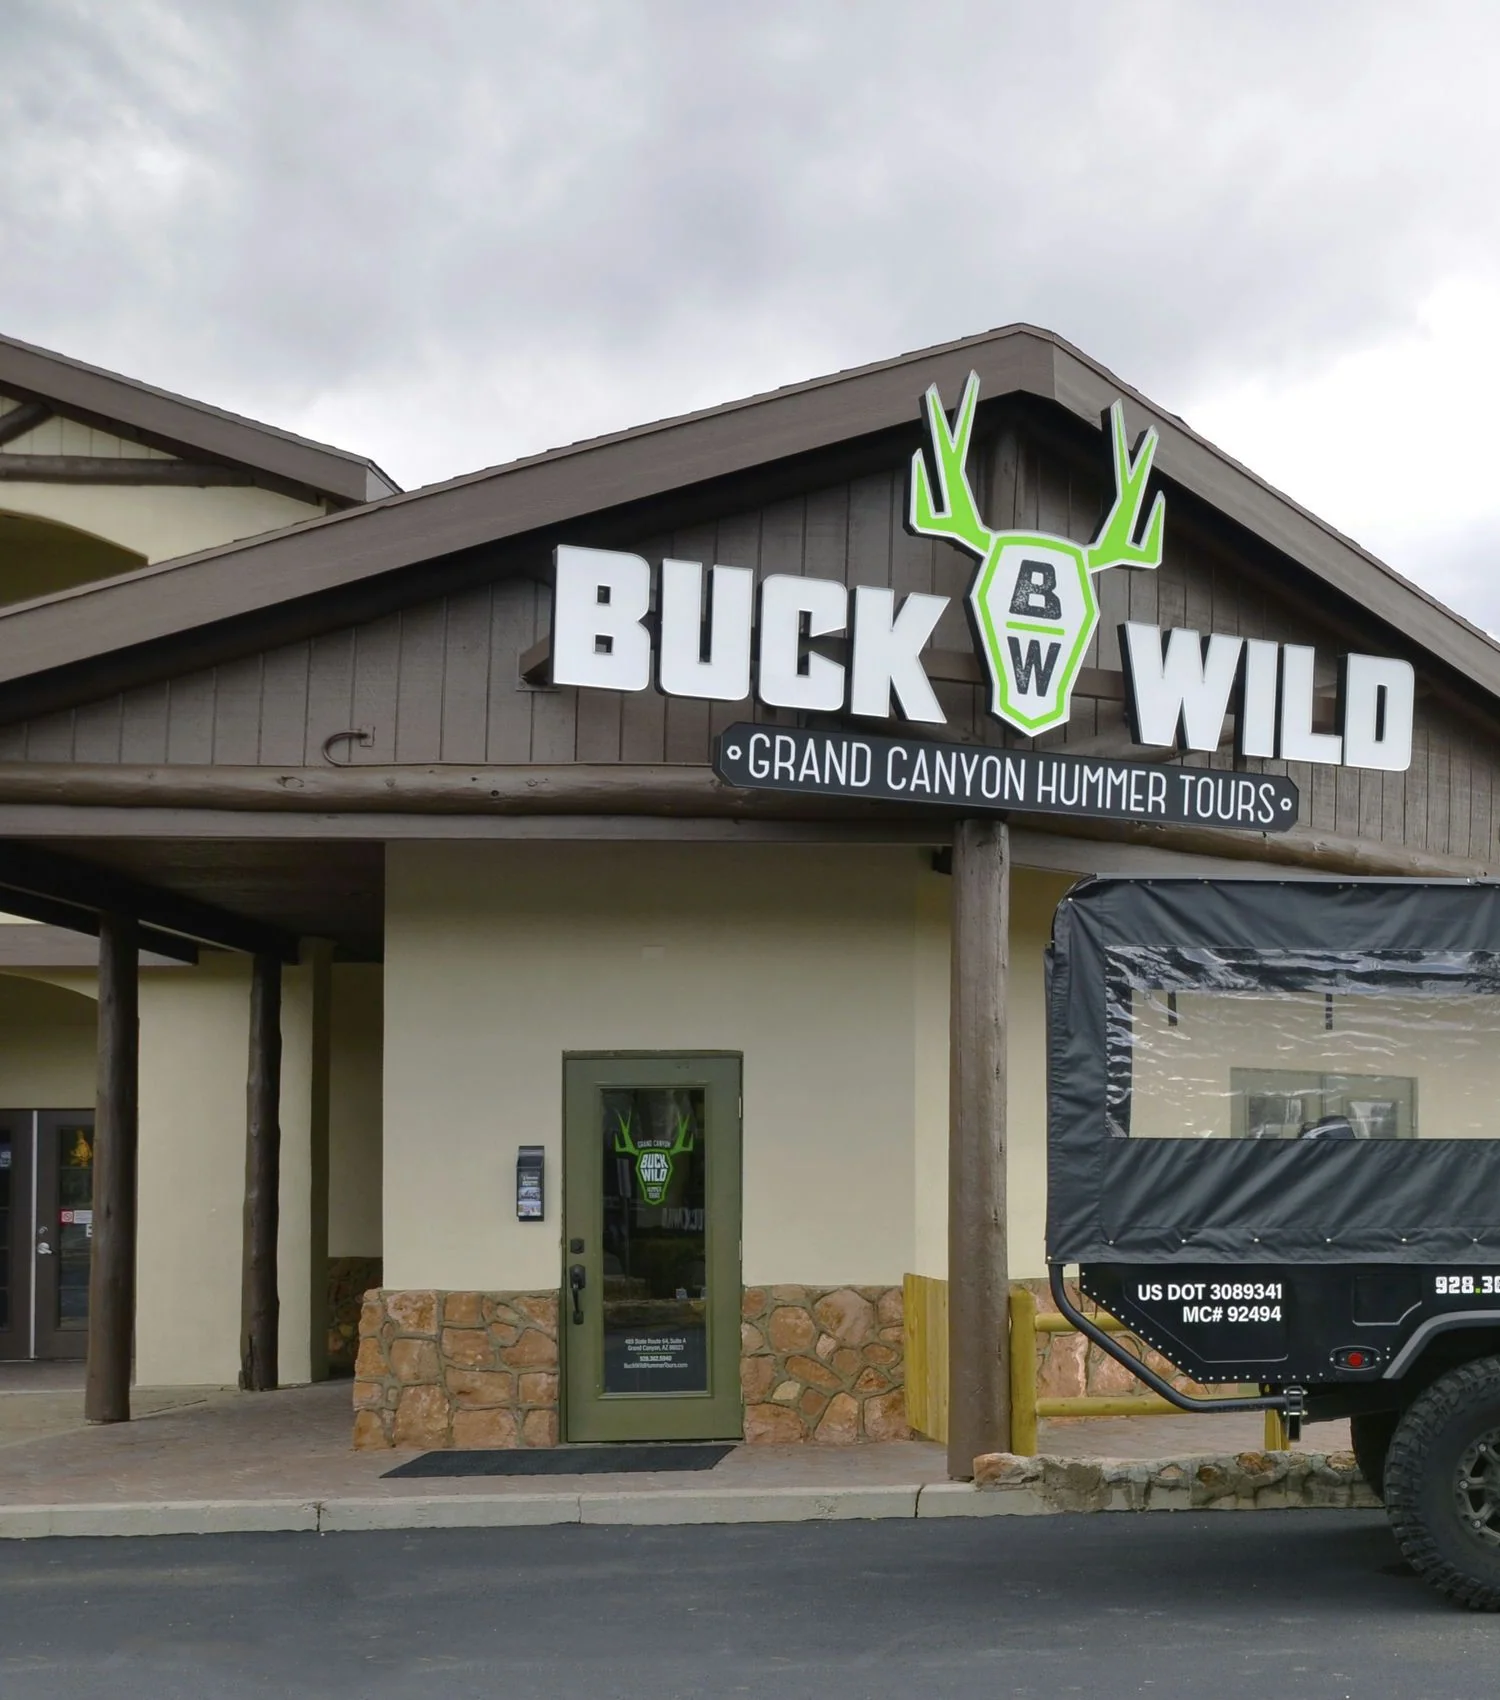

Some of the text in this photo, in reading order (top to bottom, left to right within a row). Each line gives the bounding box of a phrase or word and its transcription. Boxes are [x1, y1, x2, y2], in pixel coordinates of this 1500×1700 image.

[1008, 559, 1062, 620] B
[552, 544, 1415, 772] BUCK WILD
[1008, 637, 1061, 698] W
[747, 734, 1277, 825] GRAND CANYON HUMMER TOURS
[640, 1153, 669, 1169] BUCK
[640, 1168, 668, 1182] WILD
[1137, 1283, 1283, 1301] US DOT 3089341
[1182, 1305, 1282, 1323] MC# 92494
